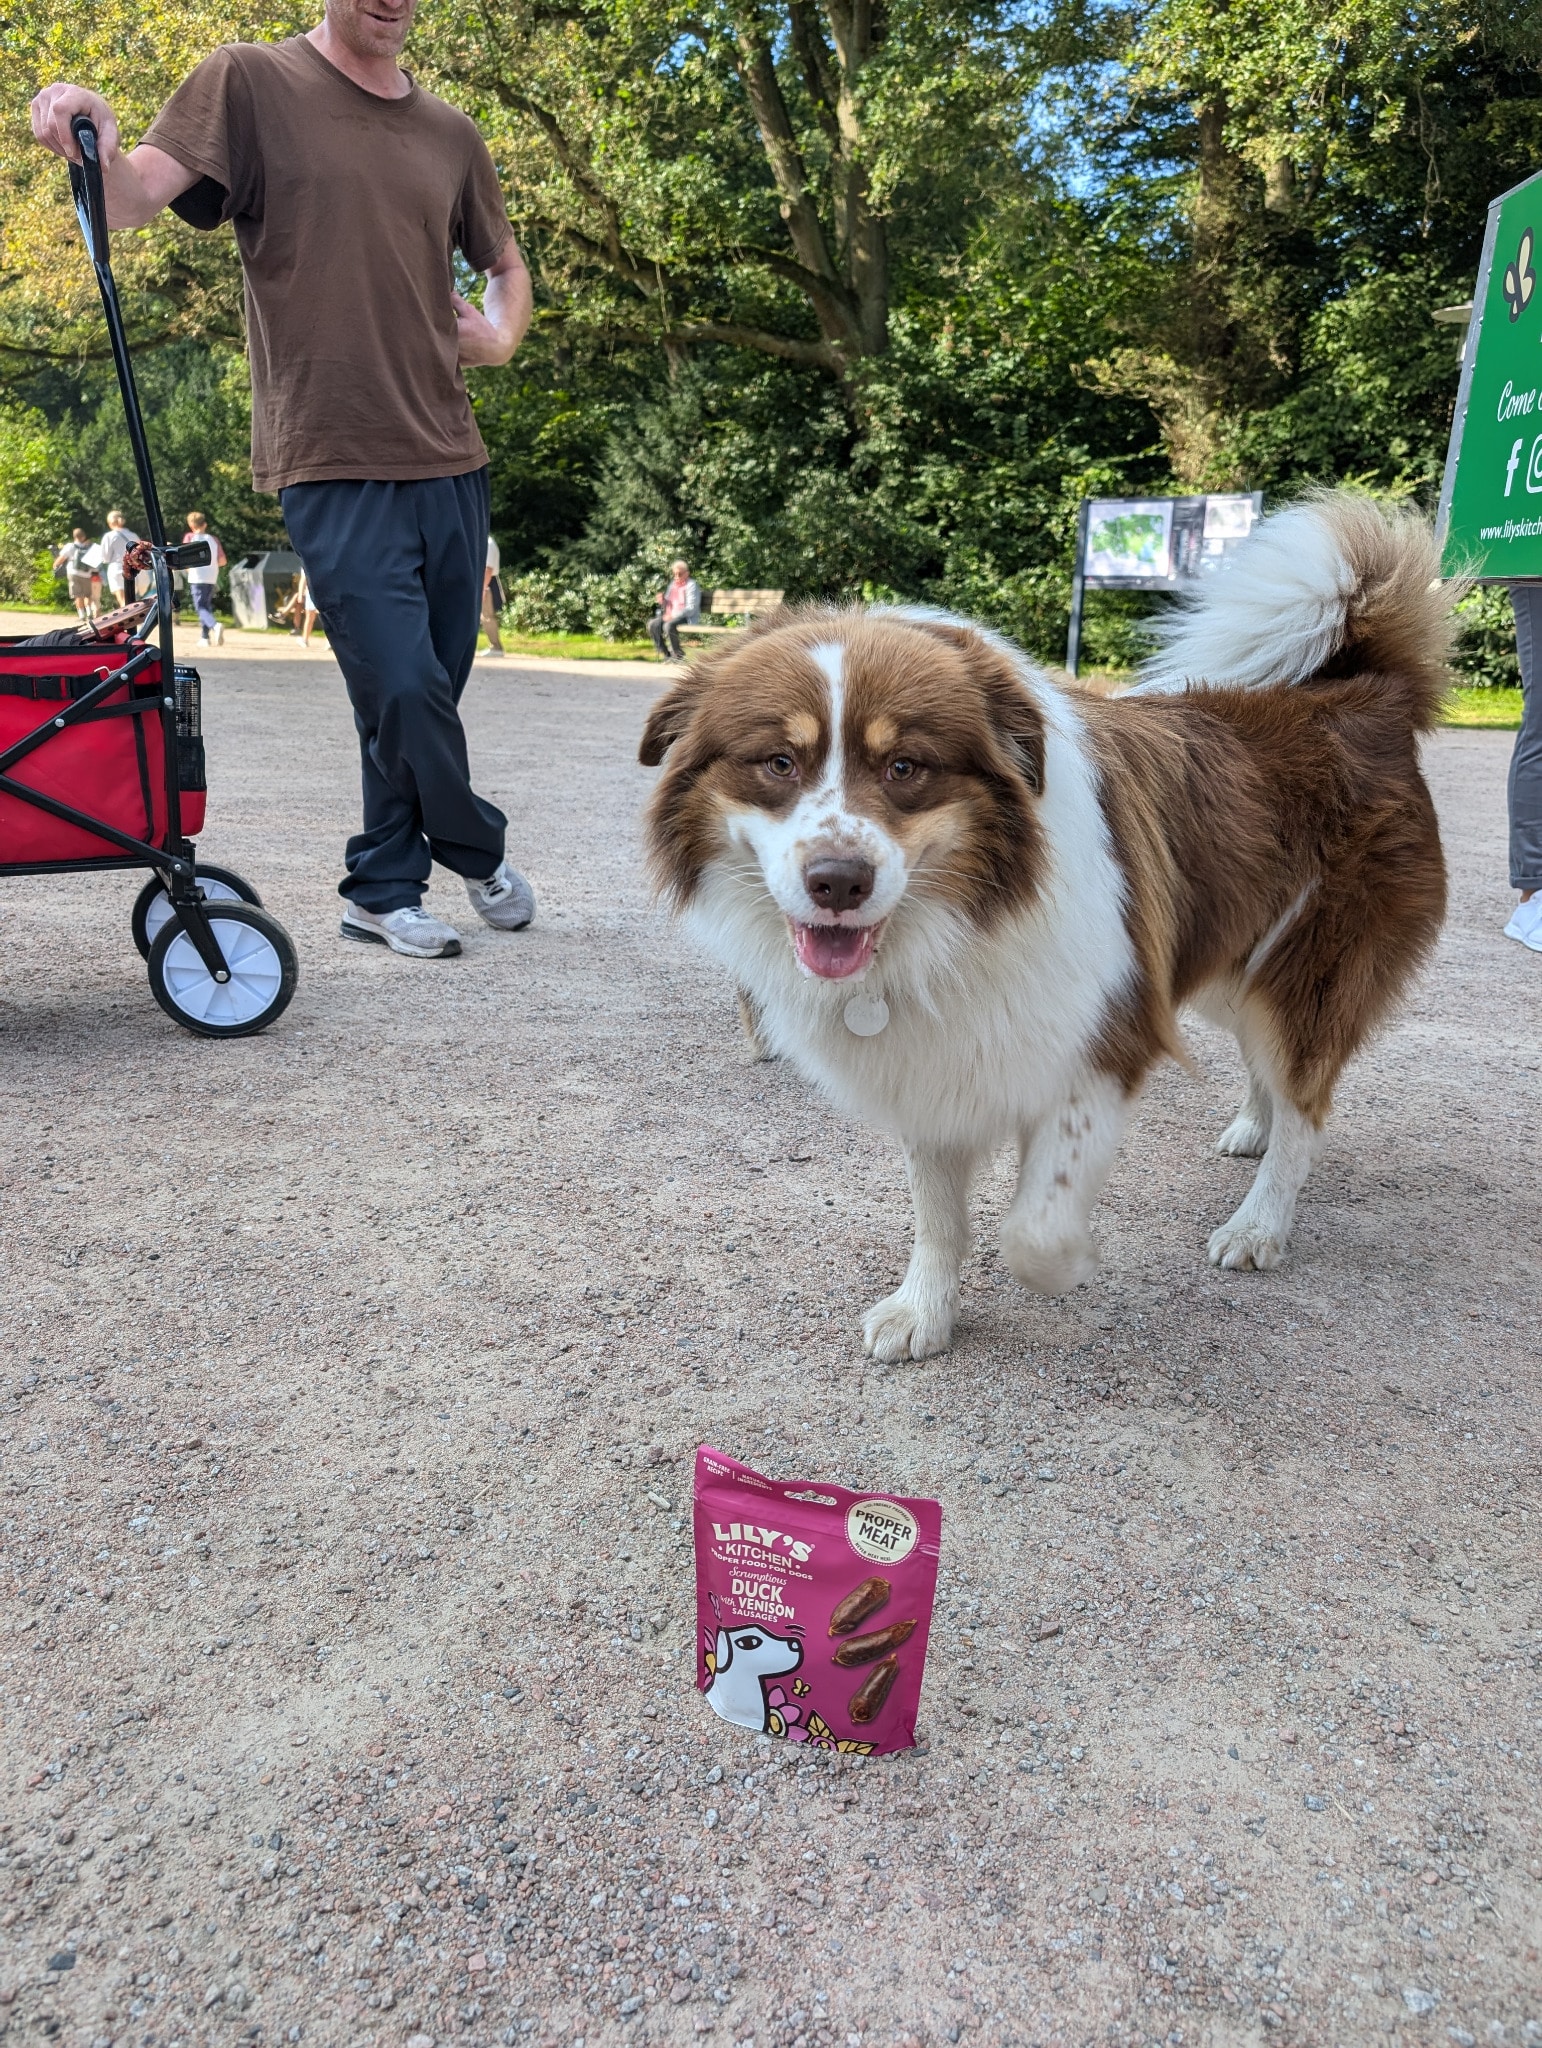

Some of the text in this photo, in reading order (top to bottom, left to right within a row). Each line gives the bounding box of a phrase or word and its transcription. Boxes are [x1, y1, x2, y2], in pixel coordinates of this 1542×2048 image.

[1497, 379, 1536, 422] Come
[855, 1509, 912, 1541] PROPER
[858, 1522, 900, 1550] MEAT
[711, 1522, 813, 1562] LILY'S
[725, 1542, 792, 1568] KITCHEN
[728, 1565, 788, 1586] Scrumptious
[741, 1559, 768, 1569] FOOD
[769, 1564, 787, 1574] FOR
[788, 1569, 814, 1581] DOGS
[731, 1578, 784, 1604] DUCK
[731, 1607, 778, 1623] SAUSAGES
[738, 1596, 795, 1620] VENISON
